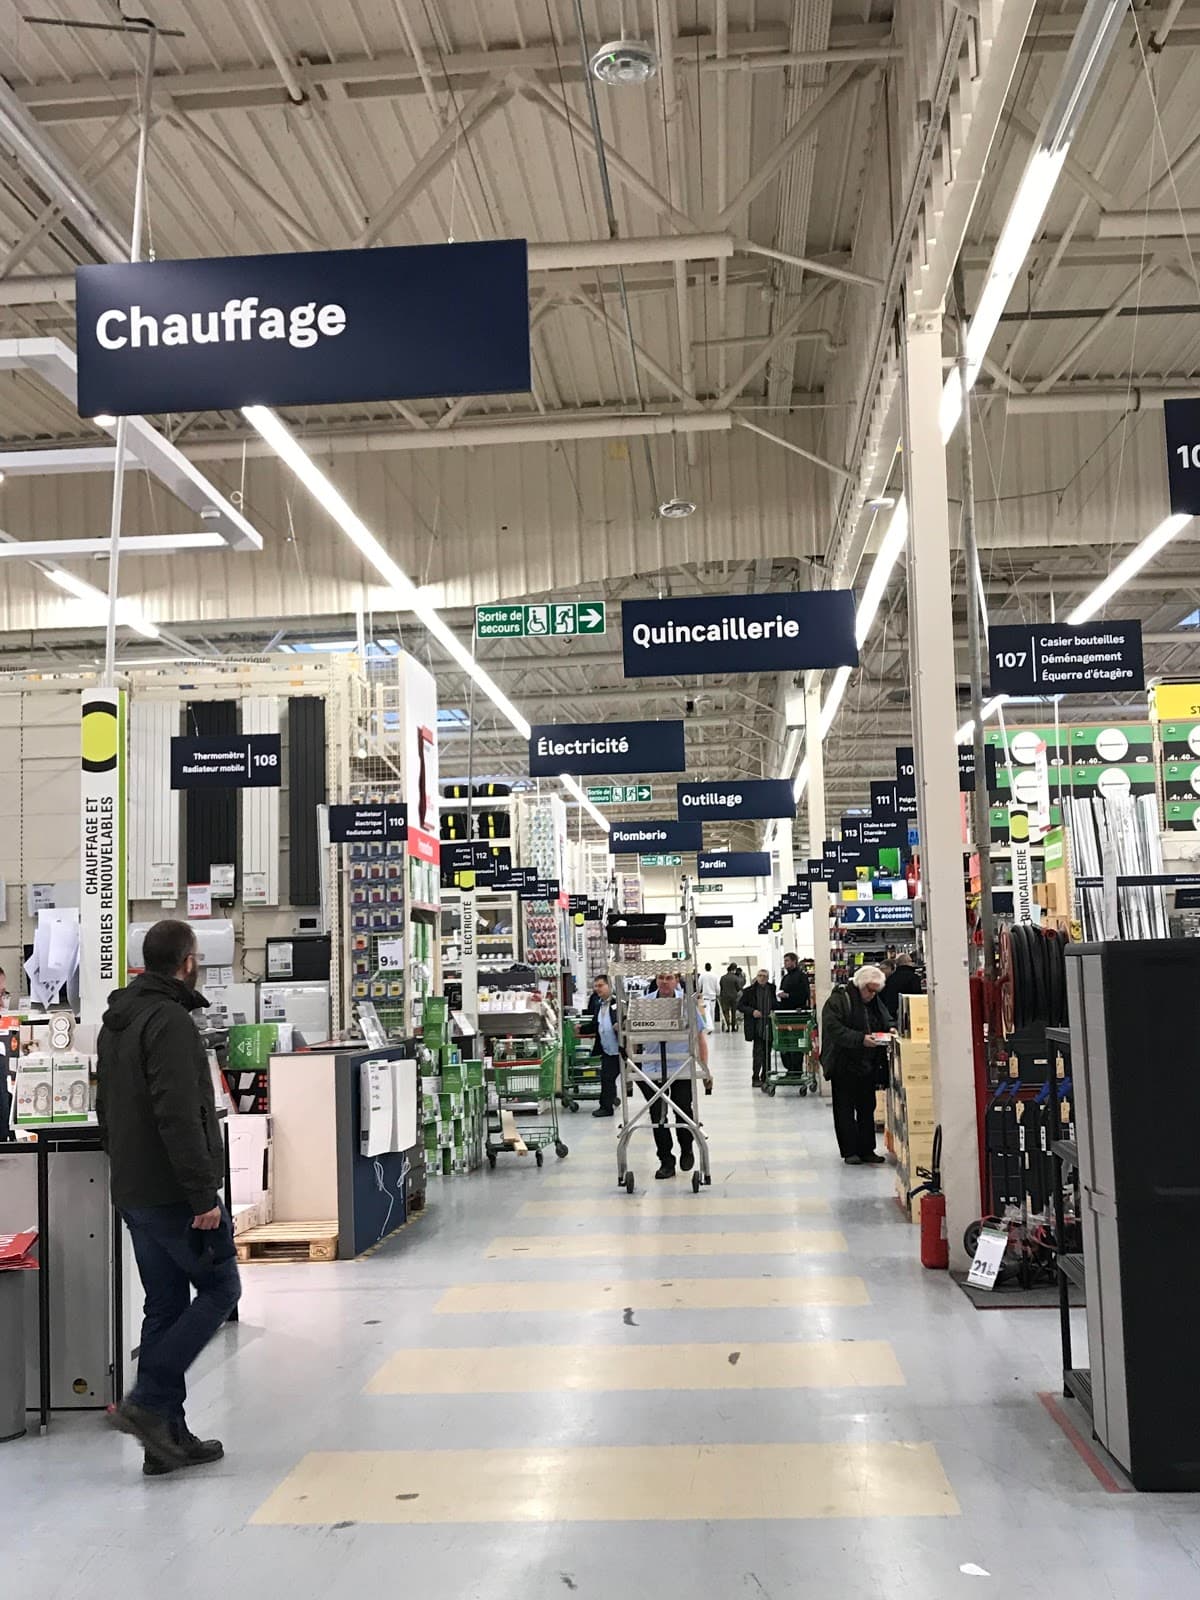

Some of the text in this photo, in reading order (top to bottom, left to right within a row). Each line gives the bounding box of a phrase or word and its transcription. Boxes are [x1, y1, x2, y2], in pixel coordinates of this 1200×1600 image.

[95, 296, 347, 350] Chauffage
[478, 610, 522, 622] Sortie de
[480, 623, 521, 634] secours
[632, 615, 800, 649] Quincaillerie
[1040, 634, 1125, 647] Casier bouteilles
[995, 652, 1027, 668] 107
[1041, 651, 1122, 665] Déménagement
[1042, 668, 1134, 683] Équerre d'étagère
[537, 735, 629, 756] Électricité
[193, 751, 245, 760] Thermomètre
[253, 754, 278, 767] 108
[182, 763, 246, 774] Radiateur mobile
[682, 792, 743, 808] Outillage
[876, 796, 890, 805] 111
[389, 817, 404, 826] 110
[612, 829, 667, 842] Plomberie
[844, 829, 858, 837] 113
[85, 797, 98, 895] CHAUFFAGE ET
[699, 859, 727, 869] Jardin
[100, 796, 113, 979] ENERGIES RENOUVELABLES
[1016, 849, 1031, 921] QUINCAILLERIE
[462, 901, 473, 955] ÉLECTRICITÉ
